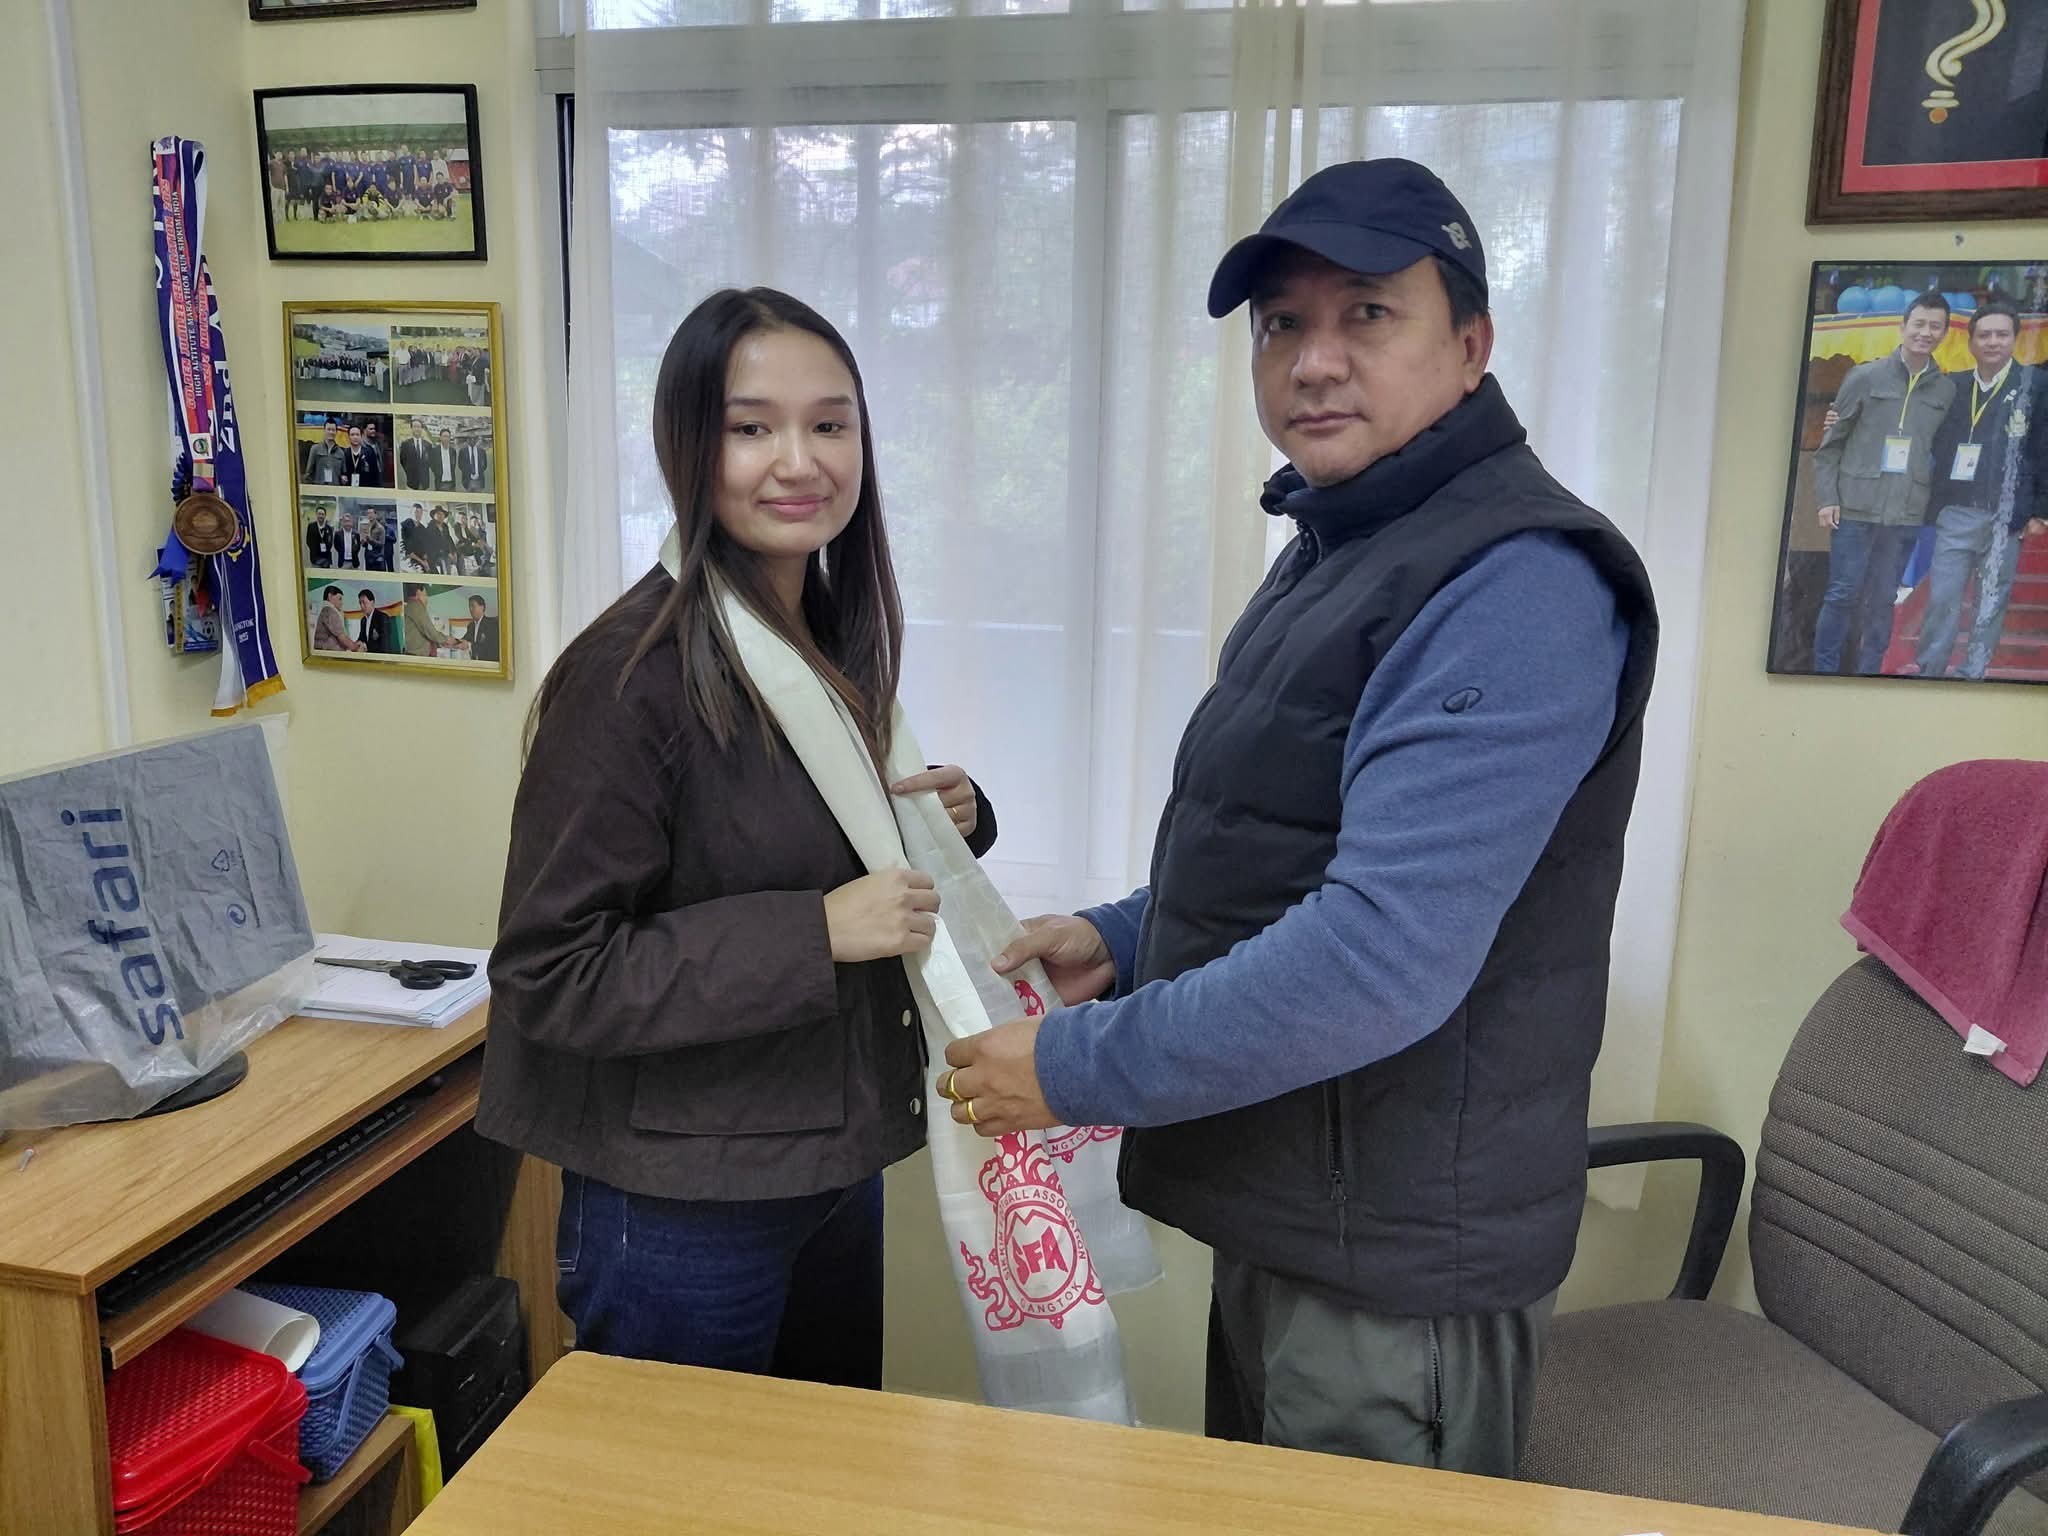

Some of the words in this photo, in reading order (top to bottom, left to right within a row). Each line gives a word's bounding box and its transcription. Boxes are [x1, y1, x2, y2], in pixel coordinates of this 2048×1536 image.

[164, 215, 184, 302] CELEBRATION
[179, 254, 189, 272] RUN
[181, 275, 195, 325] MARATHON
[173, 303, 191, 356] JUBILEE
[181, 357, 197, 409] GOLDEN
[190, 373, 202, 397] HIGH
[60, 809, 185, 1046] safari
[1033, 1188, 1087, 1260] ASSOCIATION
[1011, 1225, 1069, 1286] SFA
[1019, 1282, 1083, 1313] GANGTOK
